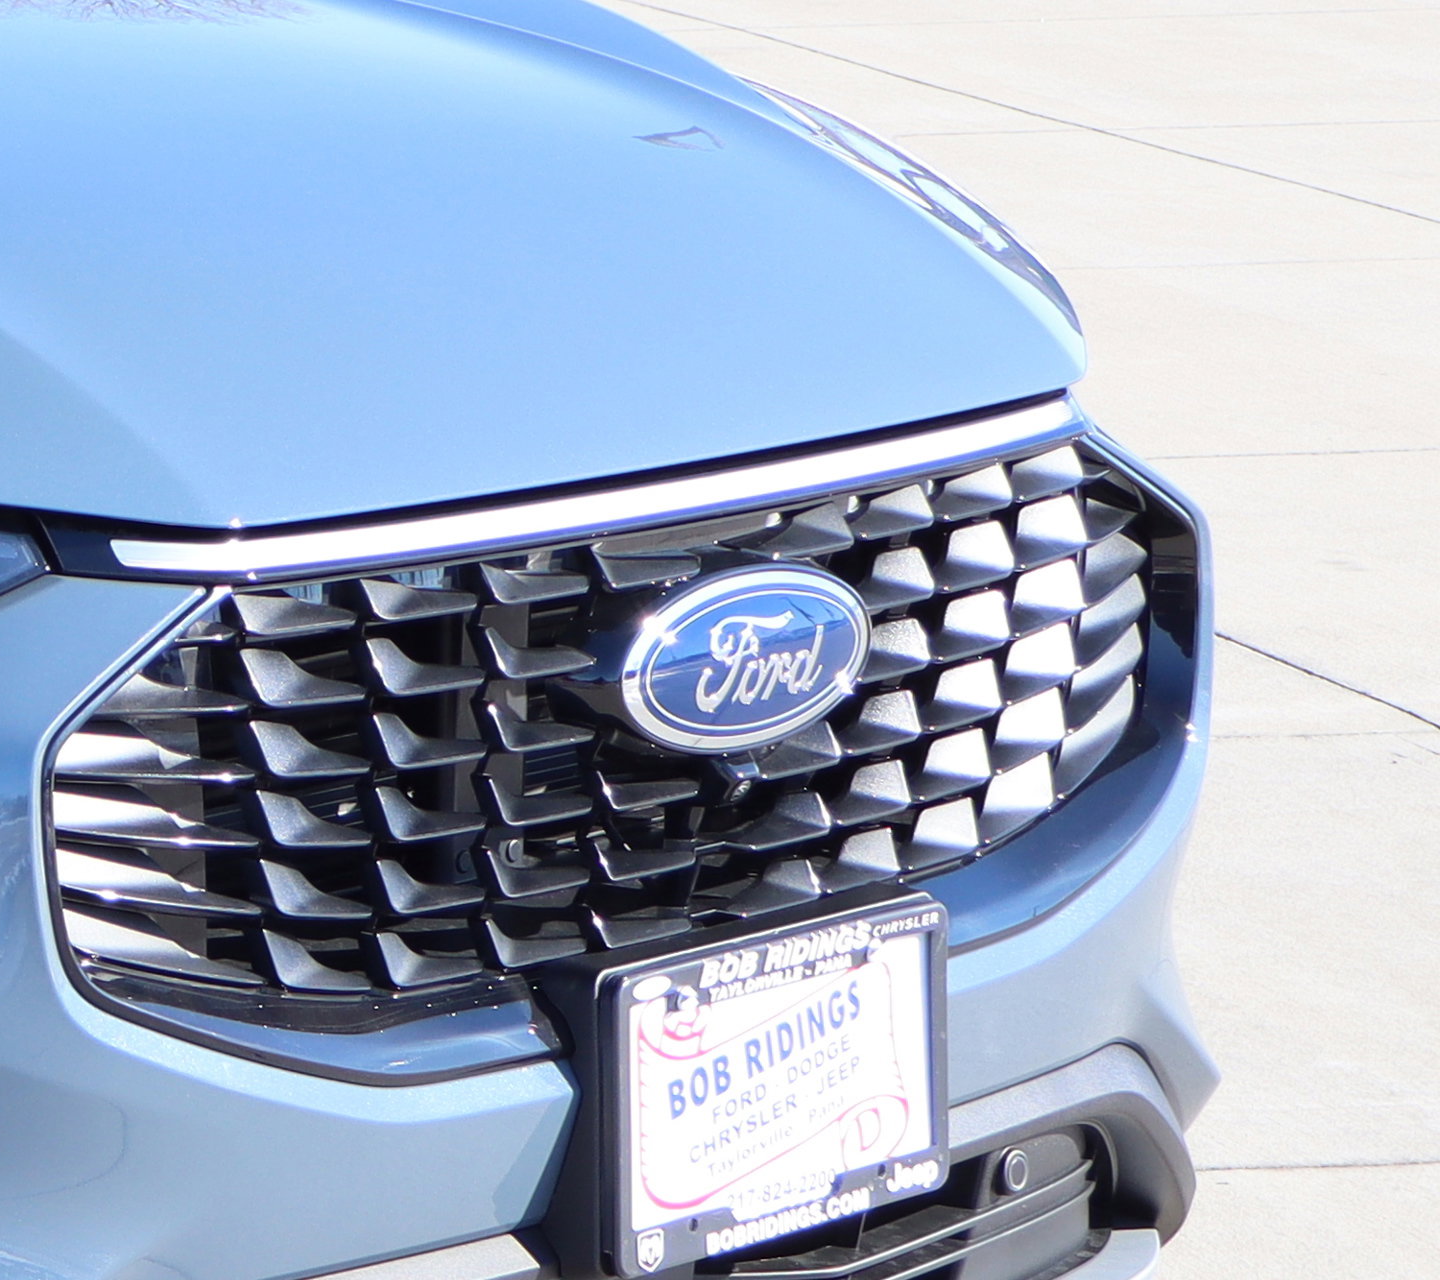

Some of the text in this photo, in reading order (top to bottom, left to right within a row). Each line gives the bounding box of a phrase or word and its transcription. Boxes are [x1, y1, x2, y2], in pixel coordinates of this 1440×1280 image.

[695, 610, 823, 713] Ford
[699, 912, 940, 989] BOB RIDINGS CHRYSLER
[709, 966, 804, 1004] TAYLORVILLE
[667, 980, 861, 1120] BOB RIDINGS
[711, 1033, 851, 1124] FORD DODGE
[689, 1055, 861, 1163] CHRYSLER JEEP
[886, 1161, 939, 1193] Jeep
[705, 1186, 871, 1256] BOBRIDINGS.COM
